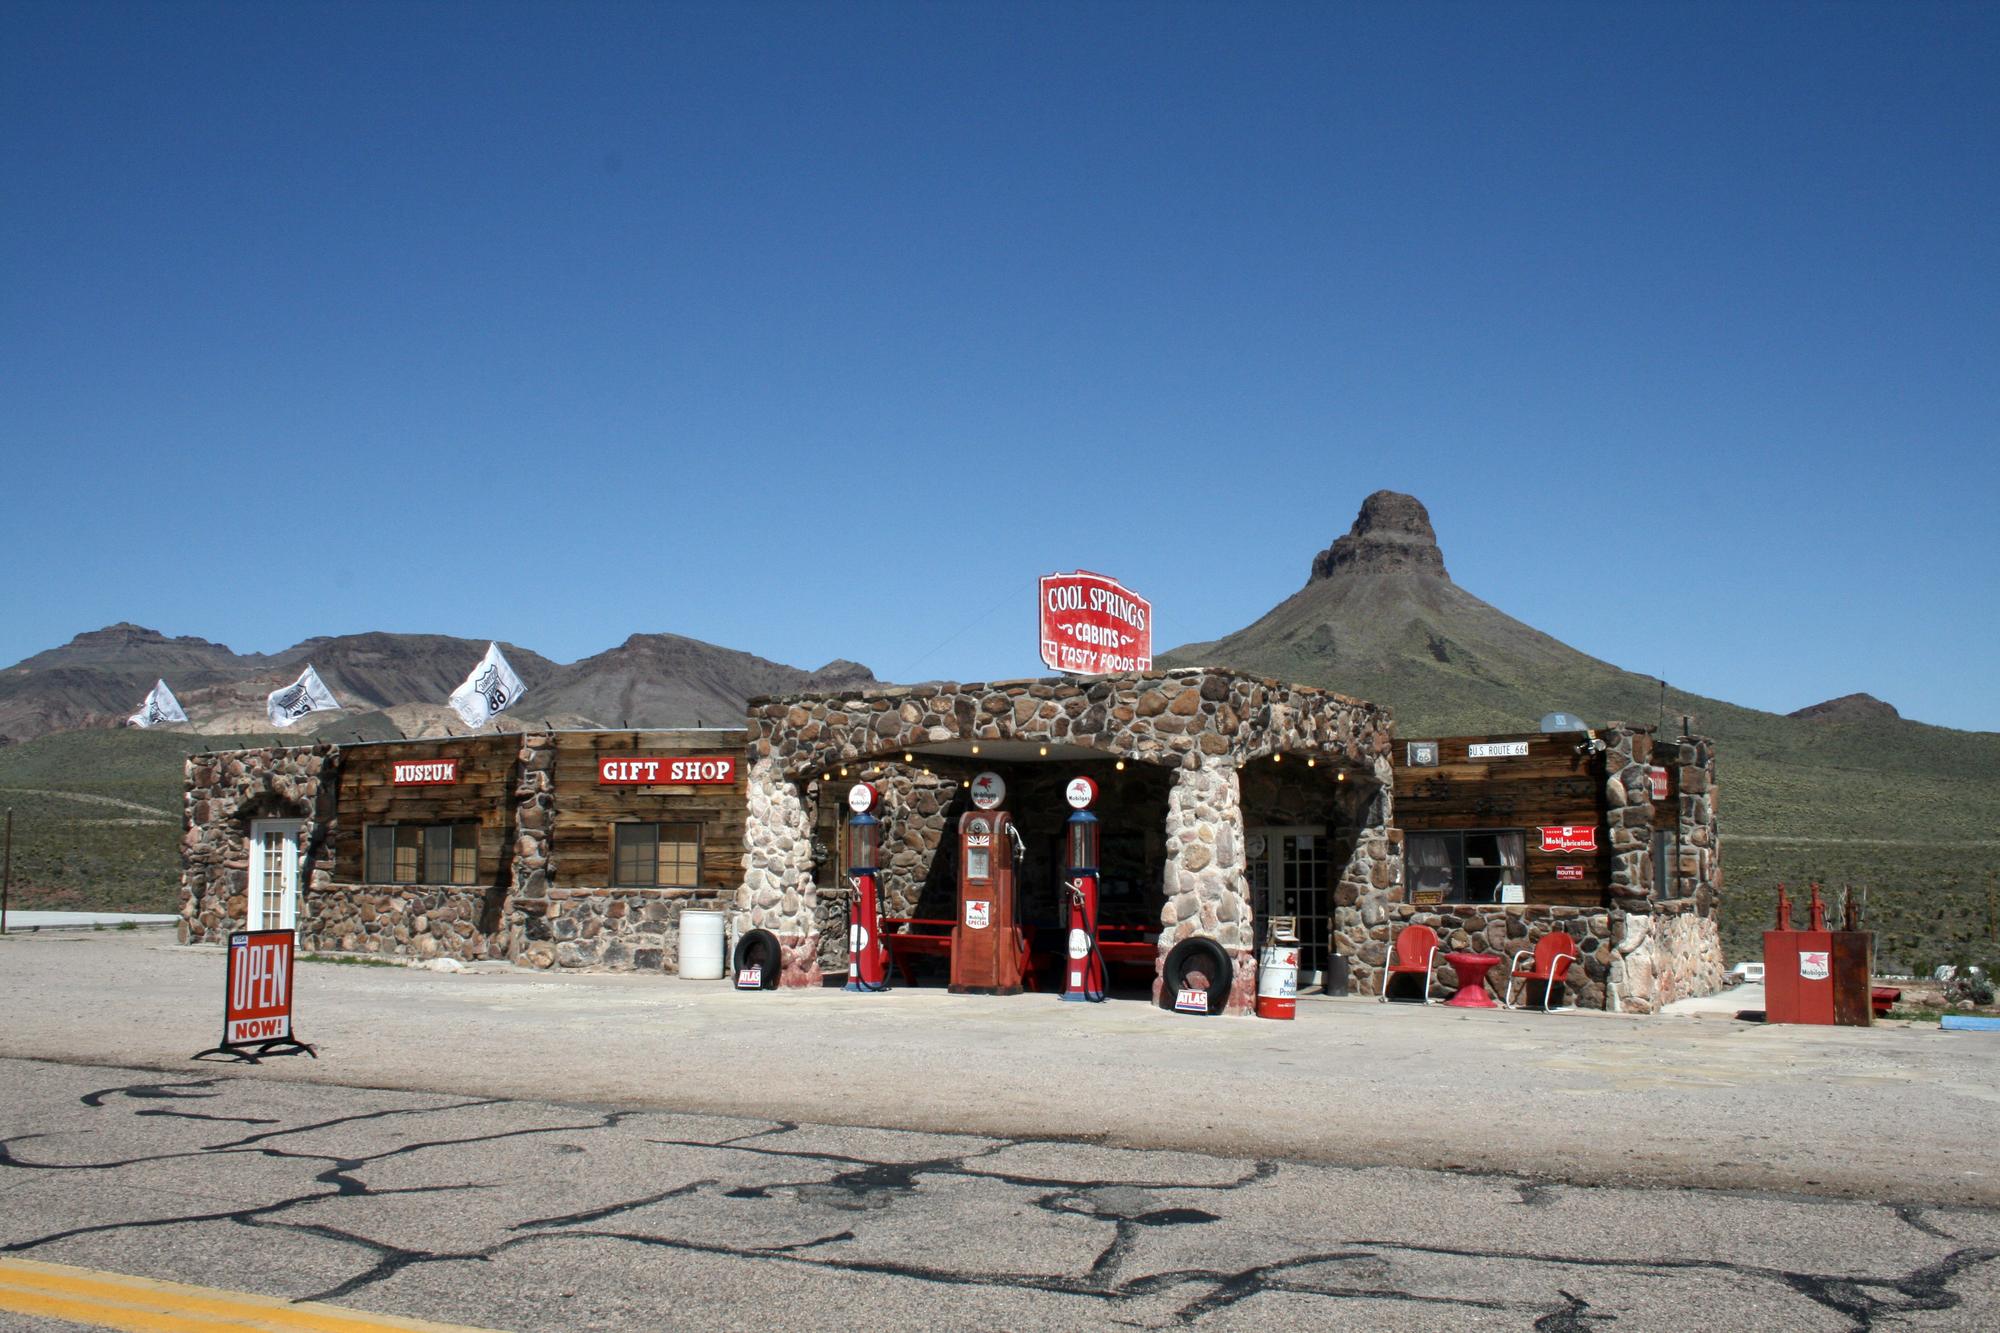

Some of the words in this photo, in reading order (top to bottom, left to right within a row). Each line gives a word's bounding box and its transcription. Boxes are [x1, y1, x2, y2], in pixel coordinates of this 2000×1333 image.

[1048, 585, 1087, 612] COOL
[1089, 587, 1145, 631] SPRINGS
[1075, 622, 1119, 649] CABINS
[1061, 644, 1098, 666] TASTY
[1100, 653, 1135, 671] FOODS
[1488, 745, 1511, 755] ROUTE
[1515, 744, 1525, 754] 66
[394, 763, 455, 783] MUSEUM
[603, 762, 658, 781] GIFT
[671, 761, 730, 780] SHOP
[233, 944, 288, 1011] OPEN
[739, 970, 760, 982] ATLAS
[1802, 968, 1828, 977] Mobilgas
[1176, 991, 1207, 1005] ATLAS
[235, 1018, 282, 1039] NOW!
